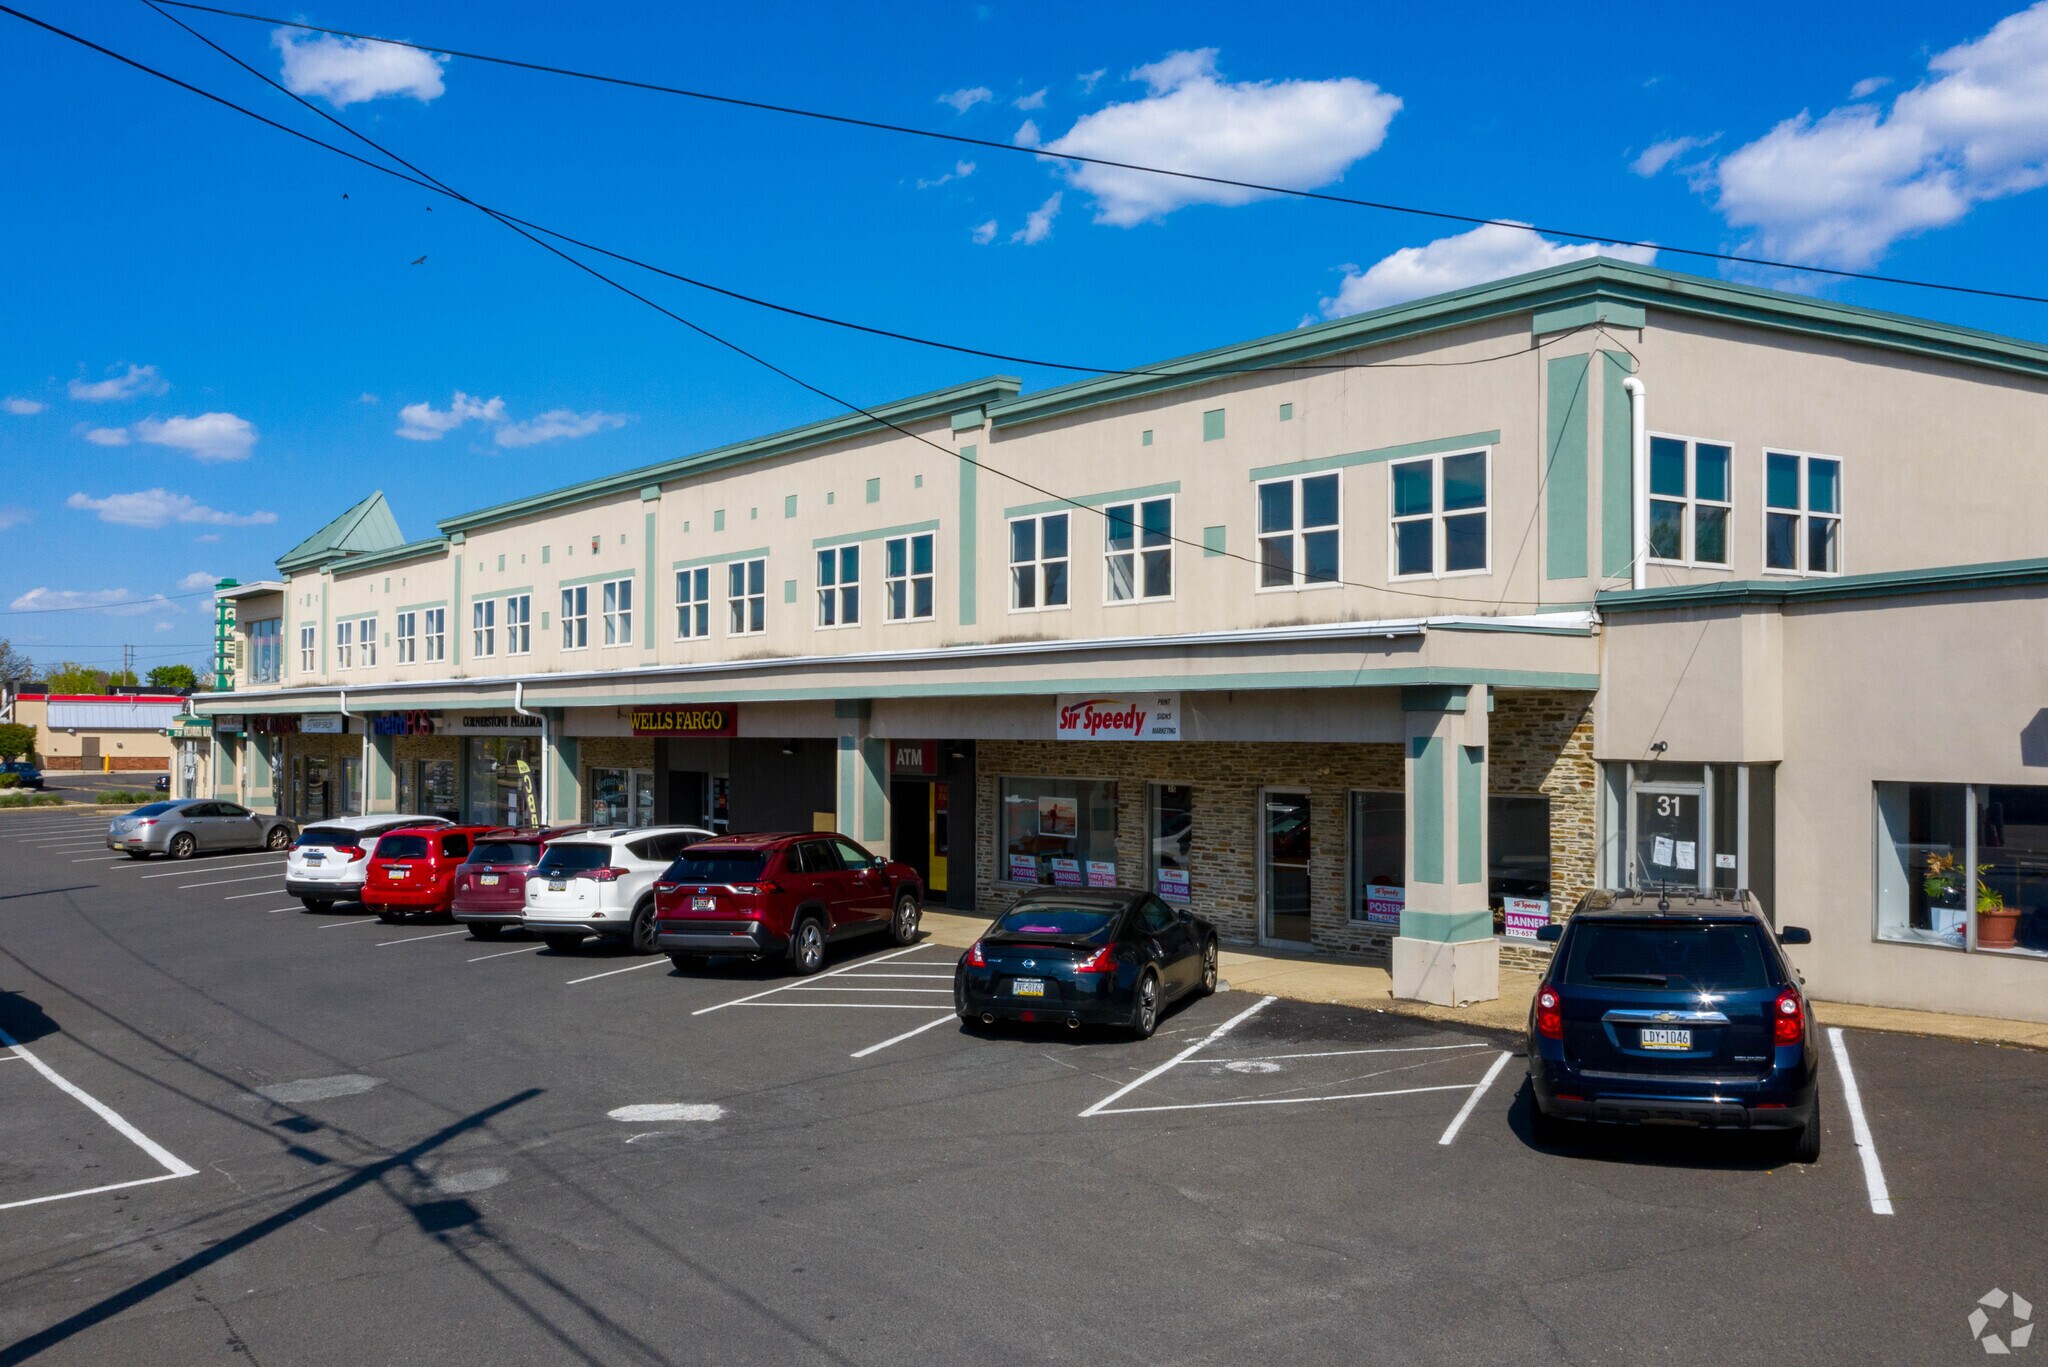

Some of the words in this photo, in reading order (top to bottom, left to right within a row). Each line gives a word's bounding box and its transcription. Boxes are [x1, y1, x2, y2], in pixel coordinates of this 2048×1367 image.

[224, 597, 236, 687] AKERY
[1158, 698, 1171, 706] PRINT
[463, 715, 508, 727] CORNERSTONE
[510, 715, 543, 727] PHARMA
[630, 712, 673, 730] WELLS
[675, 711, 722, 730] FARGO
[1060, 706, 1080, 729] Sir
[1083, 703, 1146, 736] Speedy
[1152, 727, 1177, 735] MARKETING
[896, 748, 922, 766] ATM
[1657, 795, 1680, 817] 31
[1055, 871, 1081, 880] BANNERS
[1507, 929, 1537, 937] 215-657-
